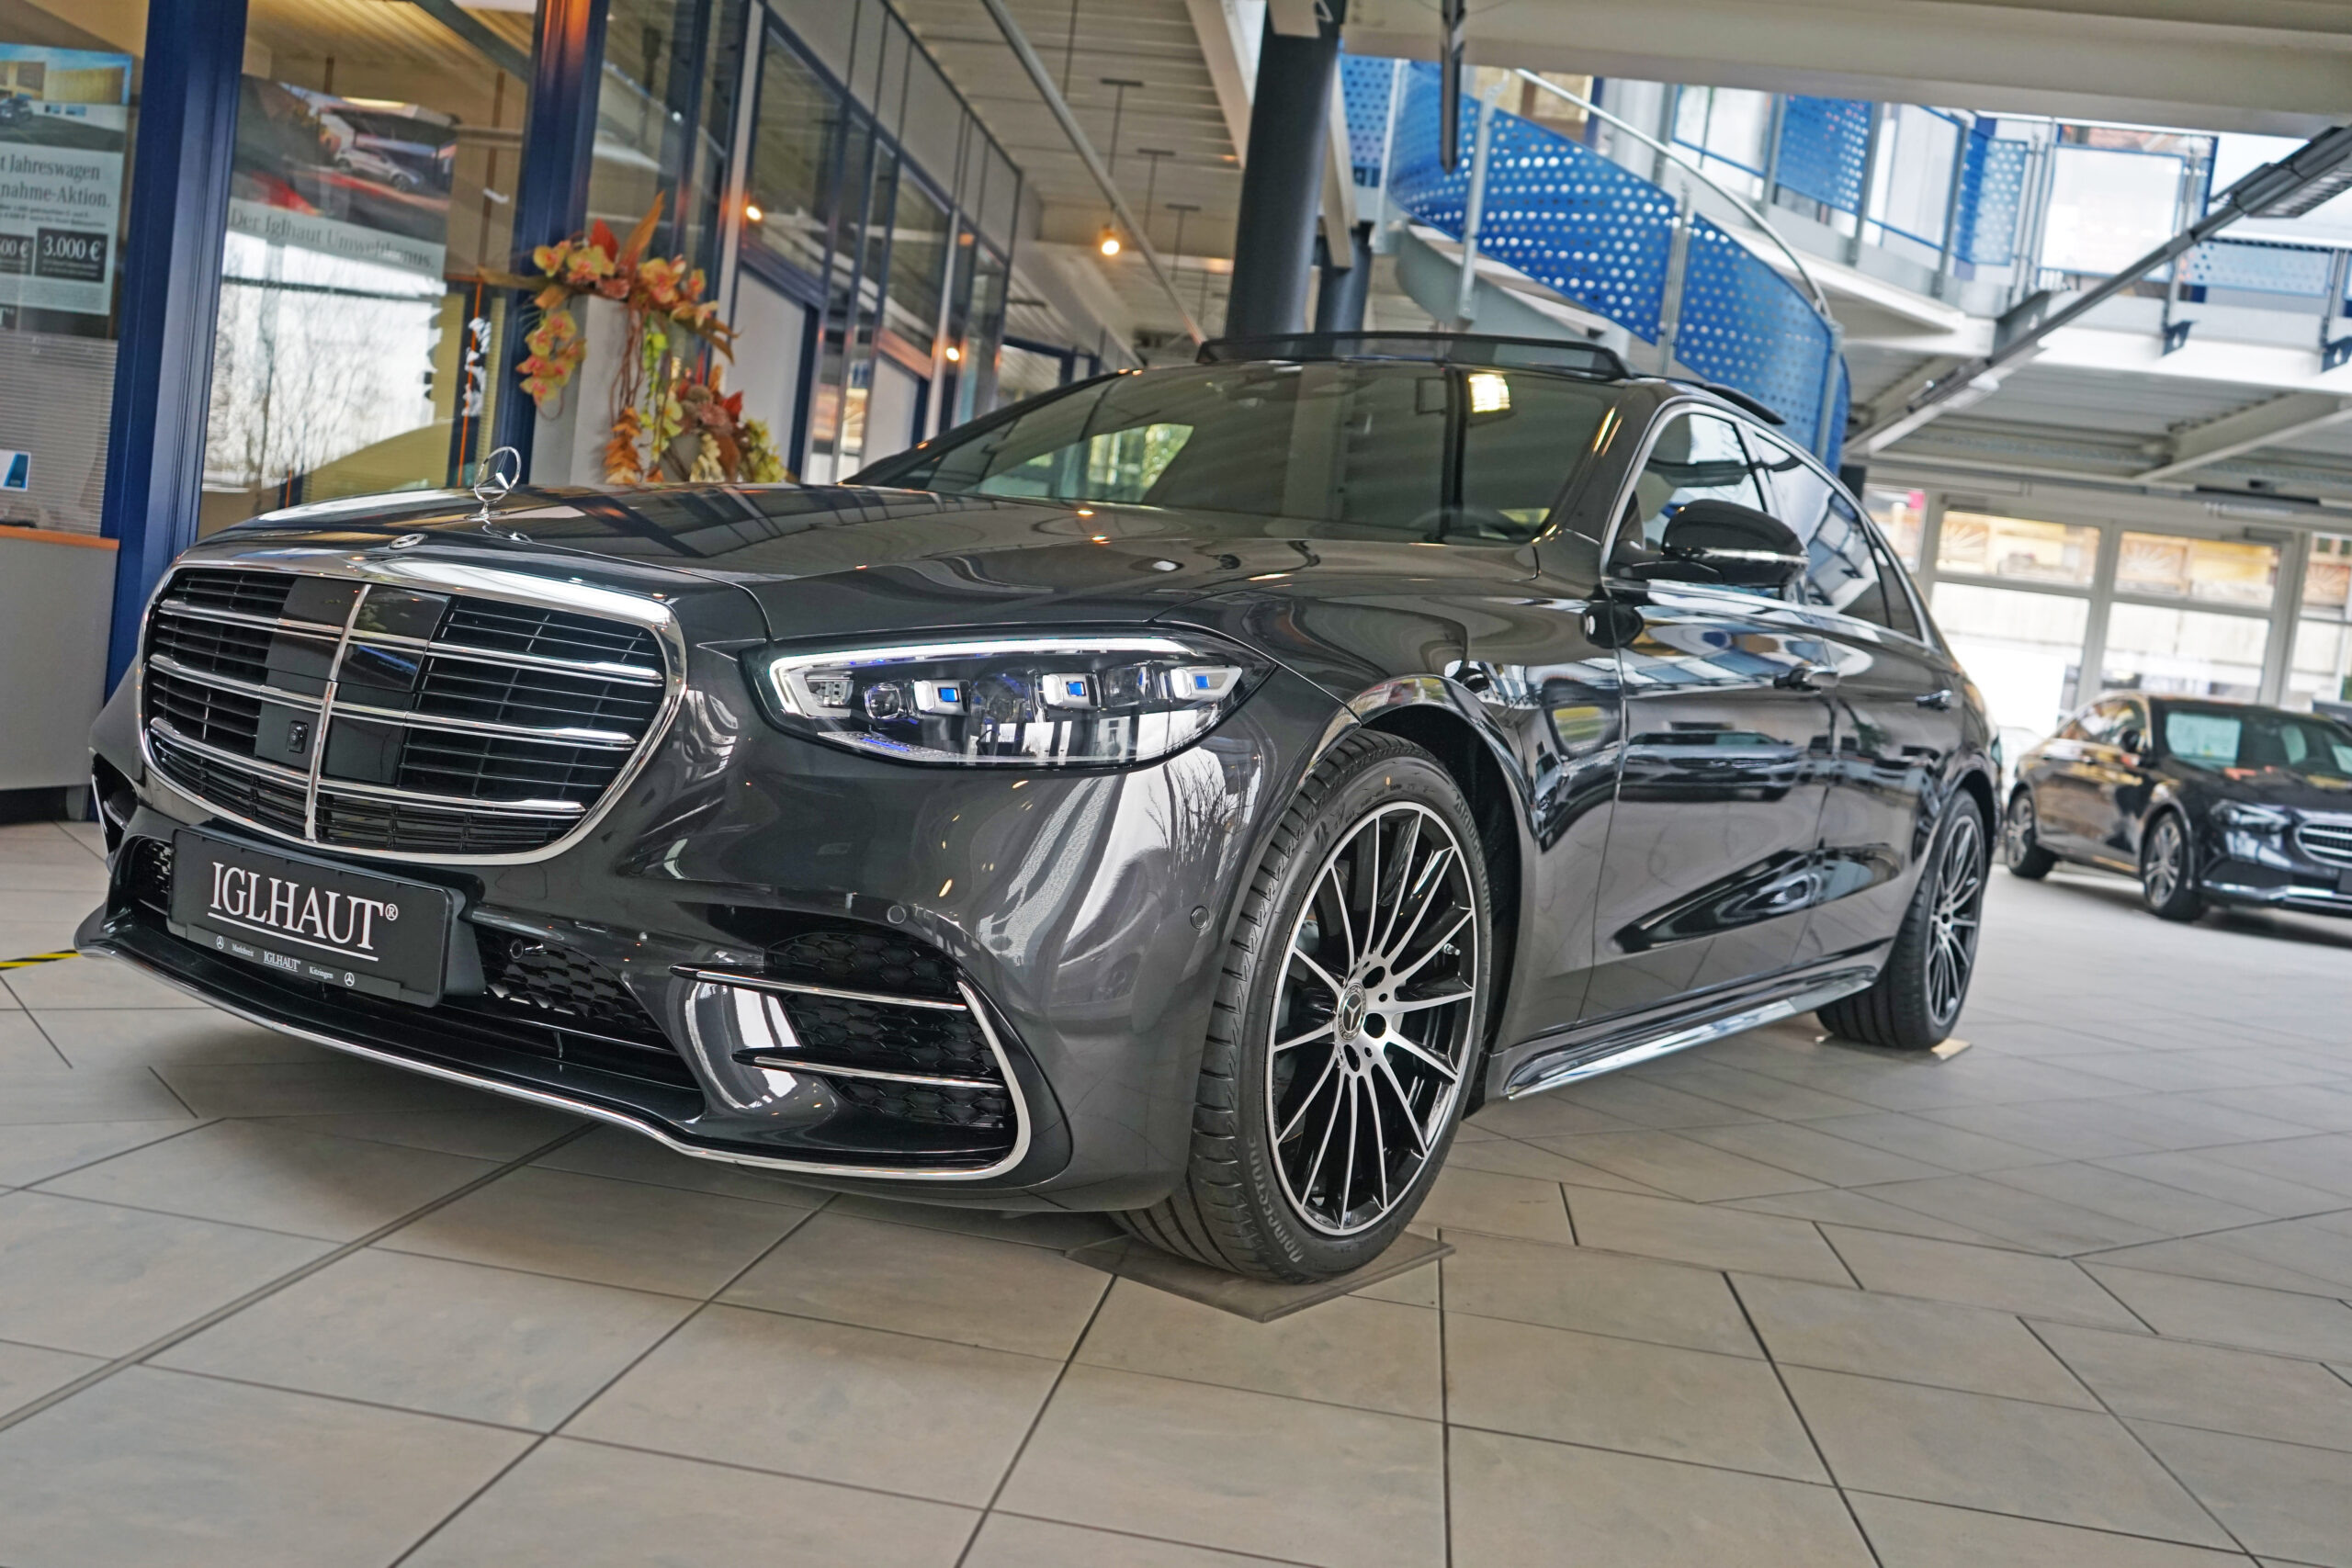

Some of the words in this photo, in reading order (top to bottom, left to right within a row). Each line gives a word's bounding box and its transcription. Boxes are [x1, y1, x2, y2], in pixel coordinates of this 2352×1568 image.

[9, 153, 100, 183] Jahreswagen
[230, 208, 261, 231] Der
[266, 213, 321, 244] Iglhaut
[43, 235, 86, 260] 3.000
